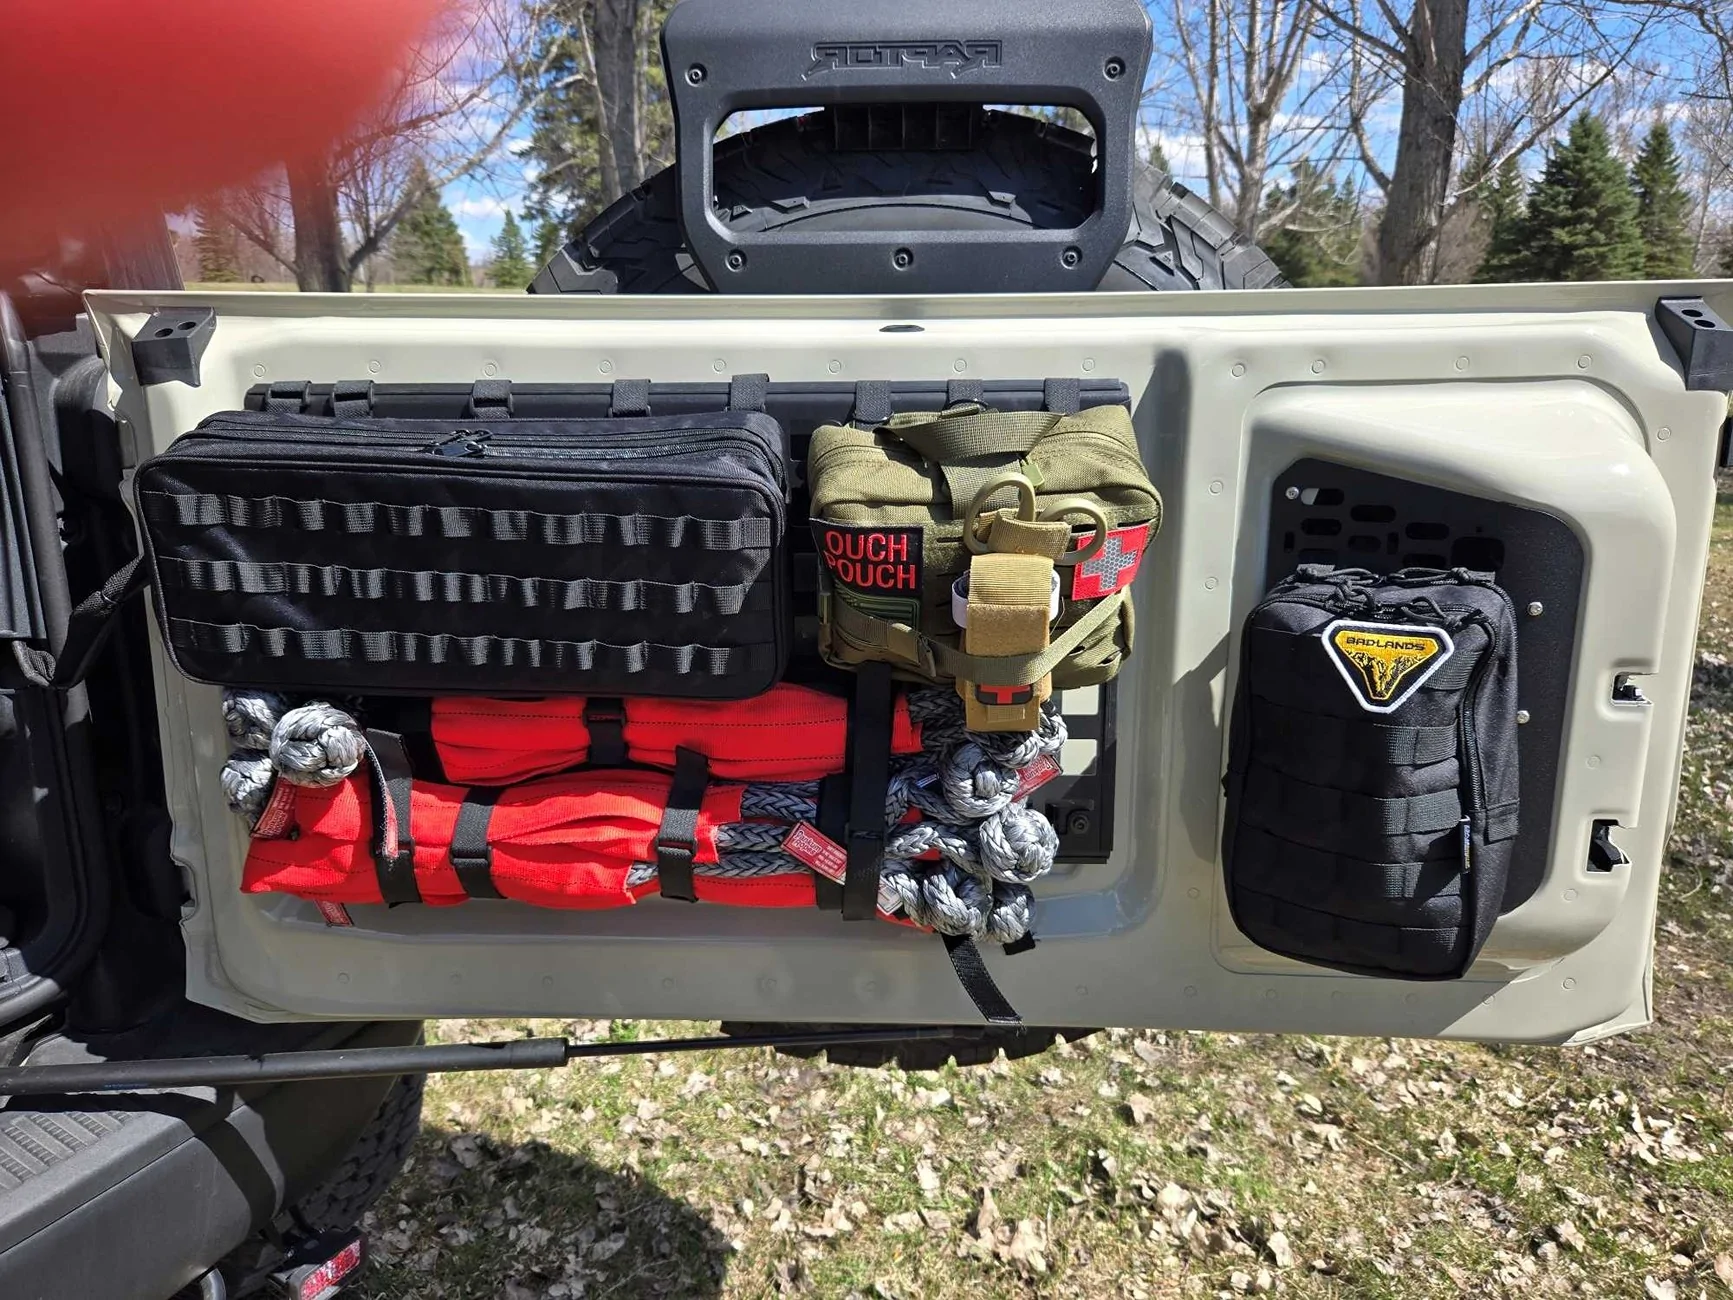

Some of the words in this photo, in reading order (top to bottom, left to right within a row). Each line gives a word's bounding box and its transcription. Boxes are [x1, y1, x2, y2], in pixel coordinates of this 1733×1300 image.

[825, 530, 907, 562] OUCH
[823, 549, 916, 590] POUCH
[1346, 637, 1425, 651] BADLANDS
